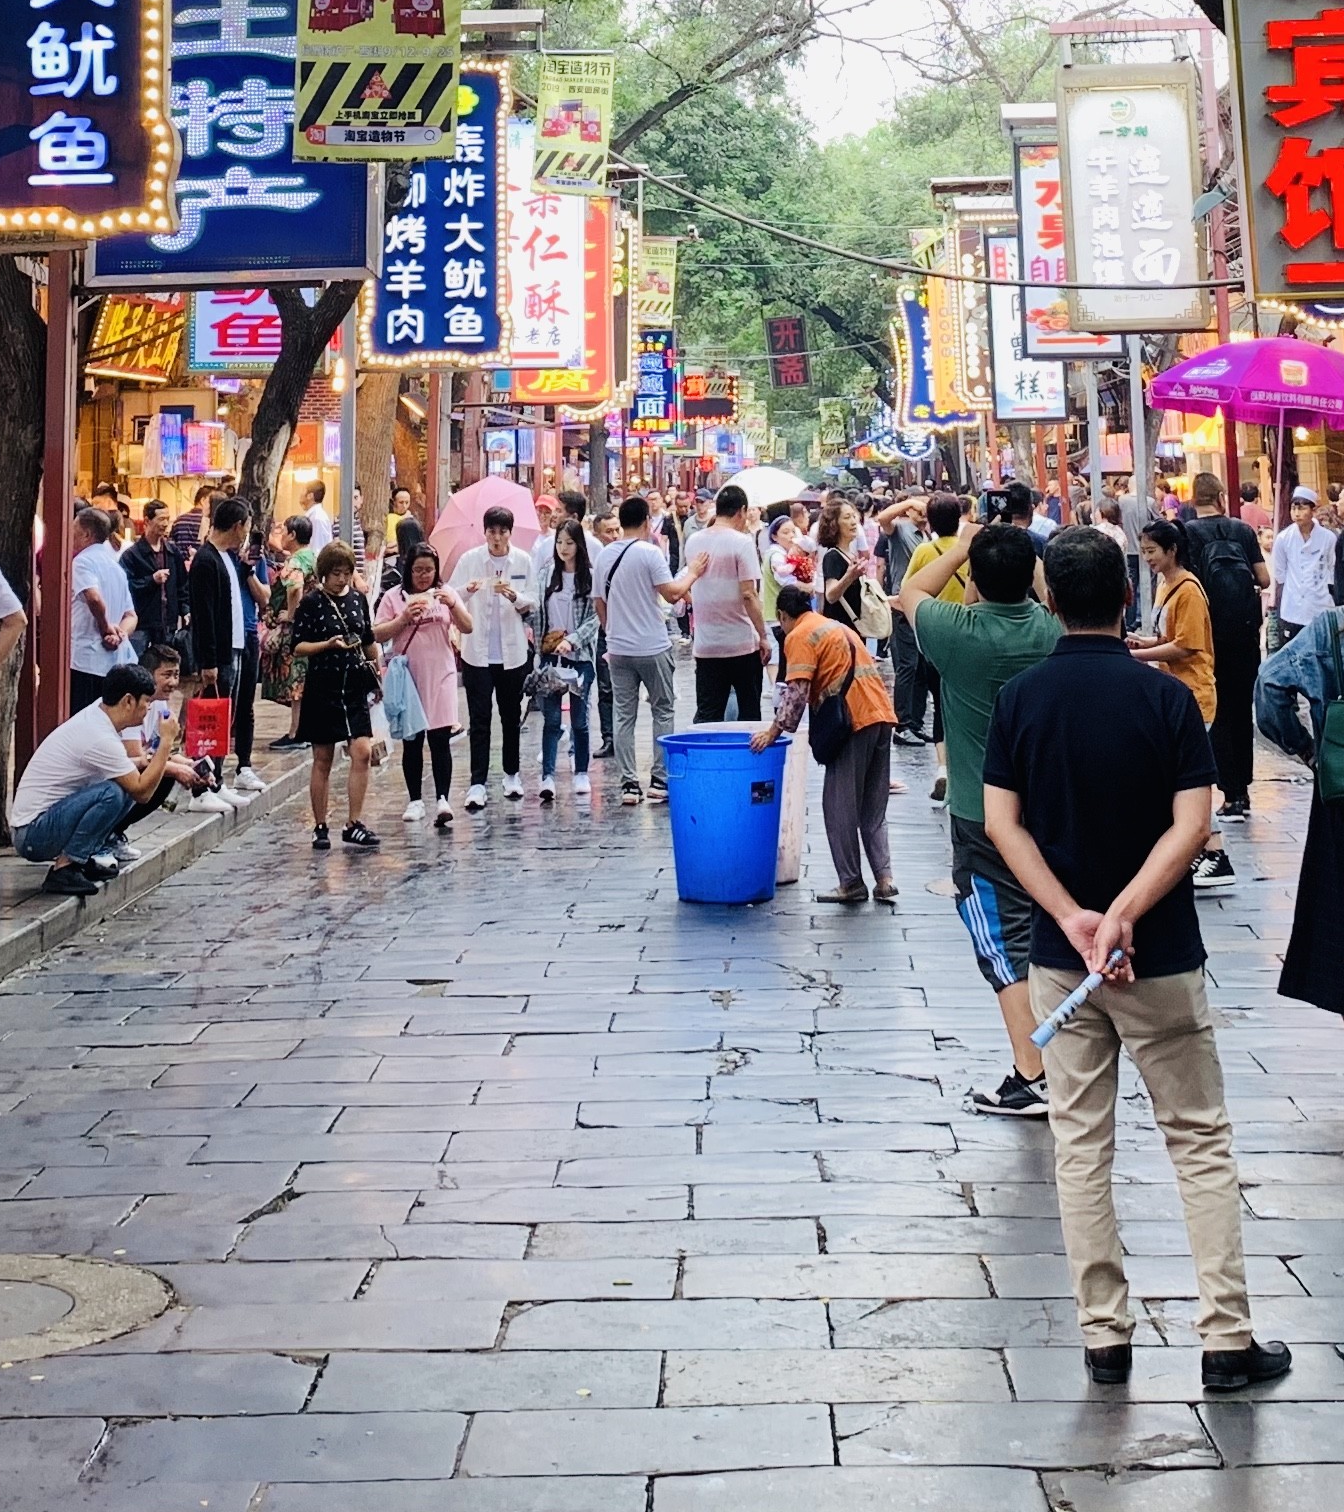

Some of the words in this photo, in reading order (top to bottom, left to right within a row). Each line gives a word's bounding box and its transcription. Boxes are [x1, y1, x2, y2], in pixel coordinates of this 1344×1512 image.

[543, 60, 610, 76] 淘宝造物节
[344, 129, 406, 143] 淘宝造物节
[443, 123, 488, 346] 轰炸大鱿鱼
[1014, 370, 1041, 401] 糕
